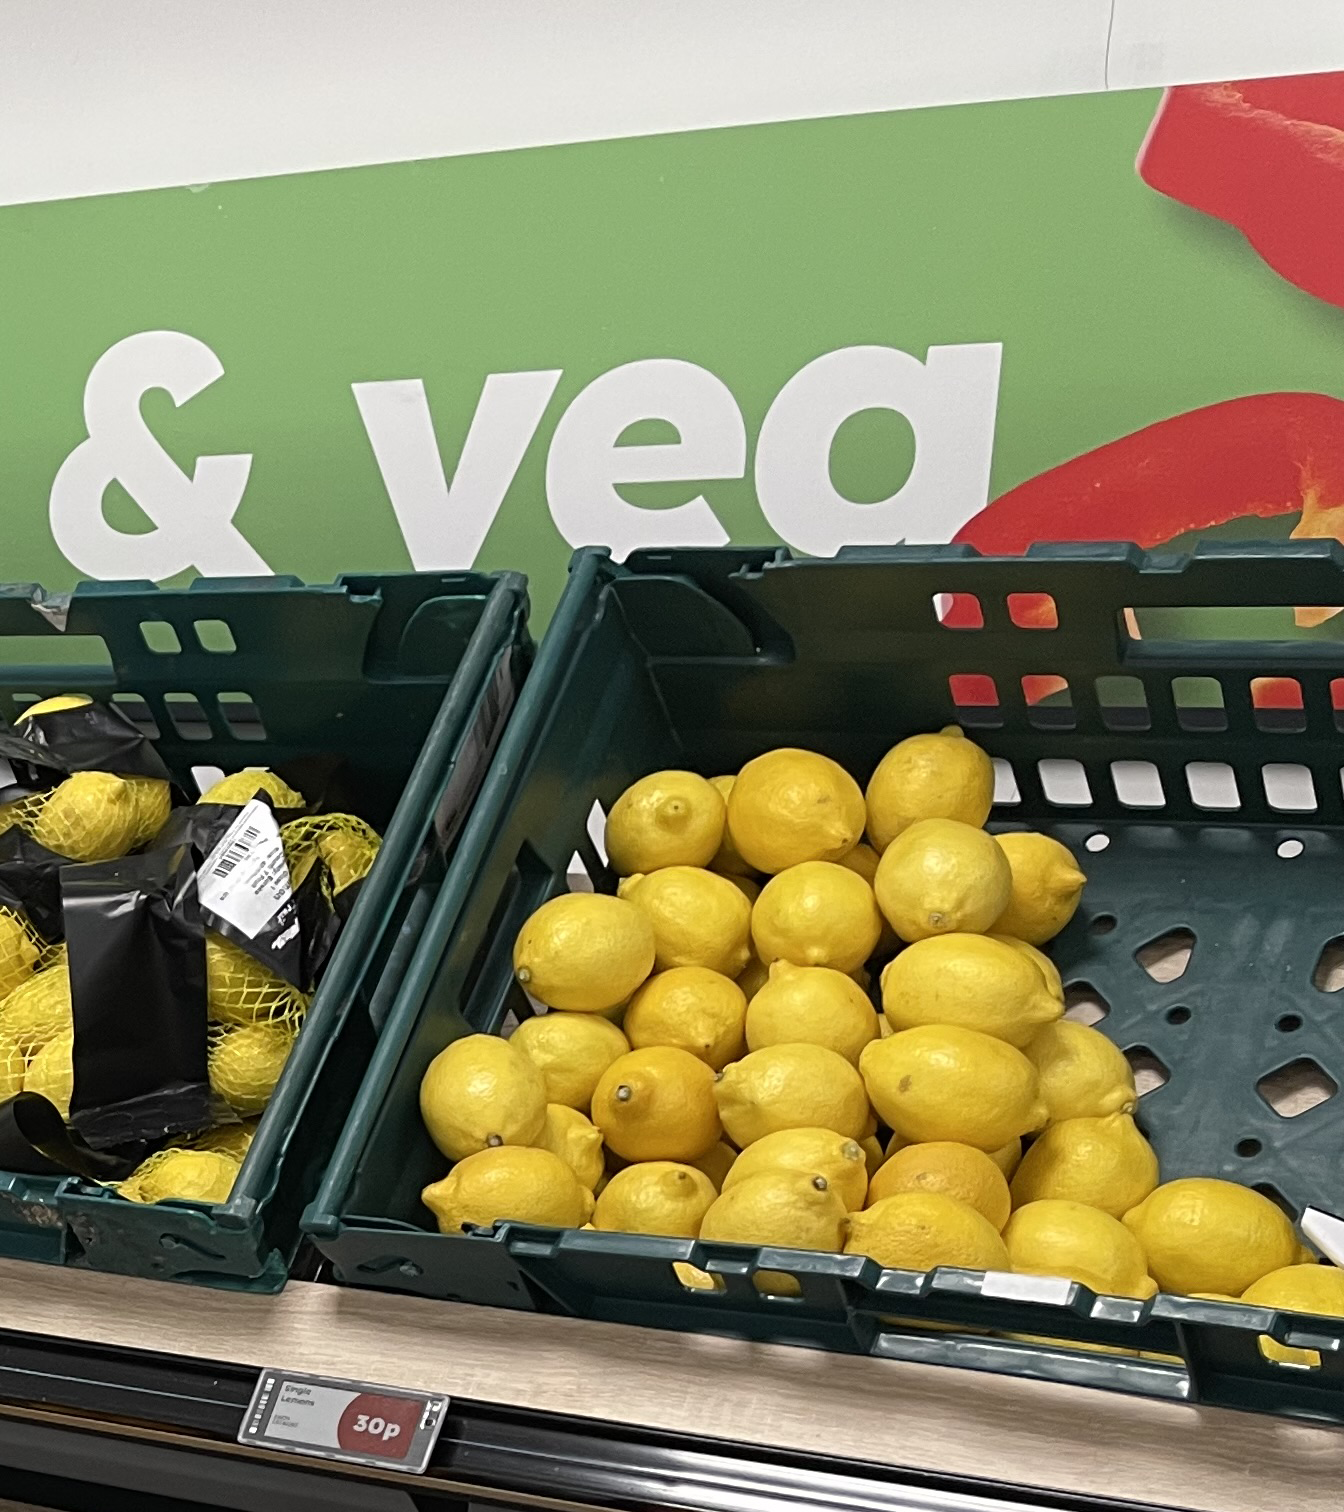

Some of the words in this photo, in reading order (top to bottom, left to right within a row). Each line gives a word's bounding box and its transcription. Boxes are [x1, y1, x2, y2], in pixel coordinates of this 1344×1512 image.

[49, 329, 276, 582] &
[284, 1384, 312, 1396] Single
[280, 1394, 315, 1407] Lemons
[352, 1414, 401, 1441] 30p
